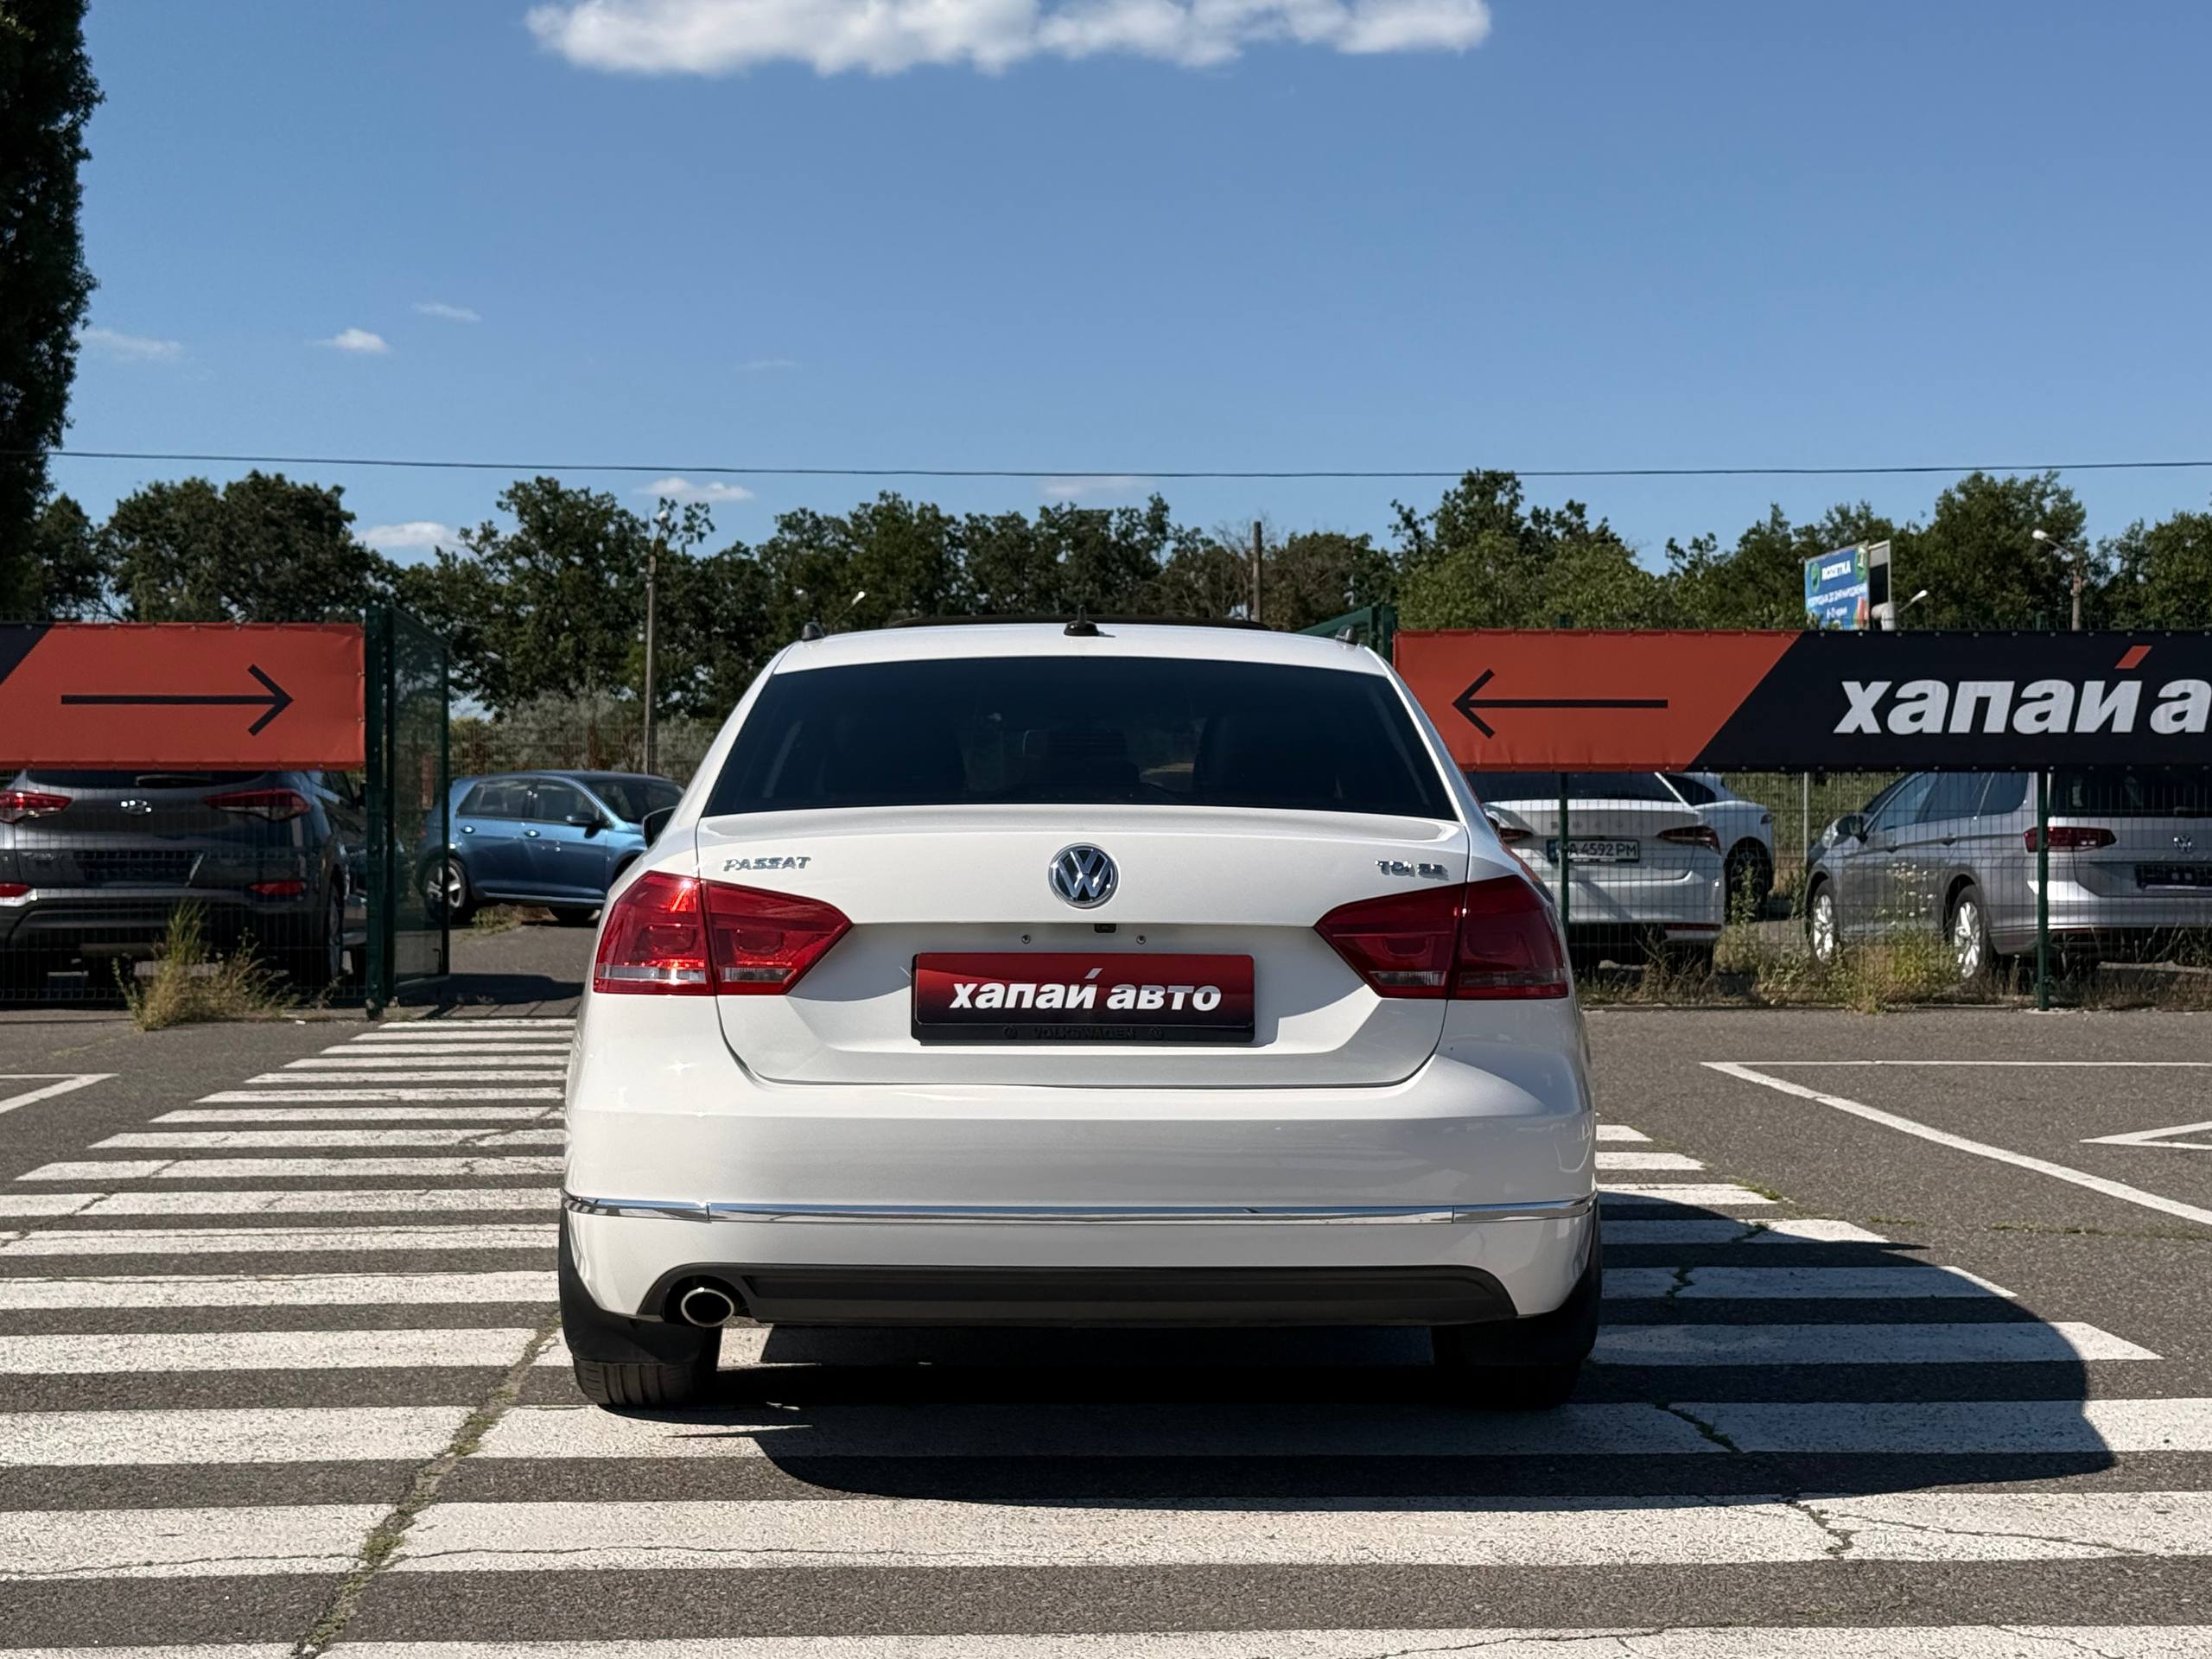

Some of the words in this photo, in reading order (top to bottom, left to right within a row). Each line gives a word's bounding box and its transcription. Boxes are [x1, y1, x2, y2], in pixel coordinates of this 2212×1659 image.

[1833, 645, 2152, 734] хапай
[723, 856, 811, 872] PASSAT
[950, 968, 1103, 1009] хапай
[1107, 984, 1222, 1012] авто
[1034, 1027, 1136, 1039] VOLKSWAGEN
